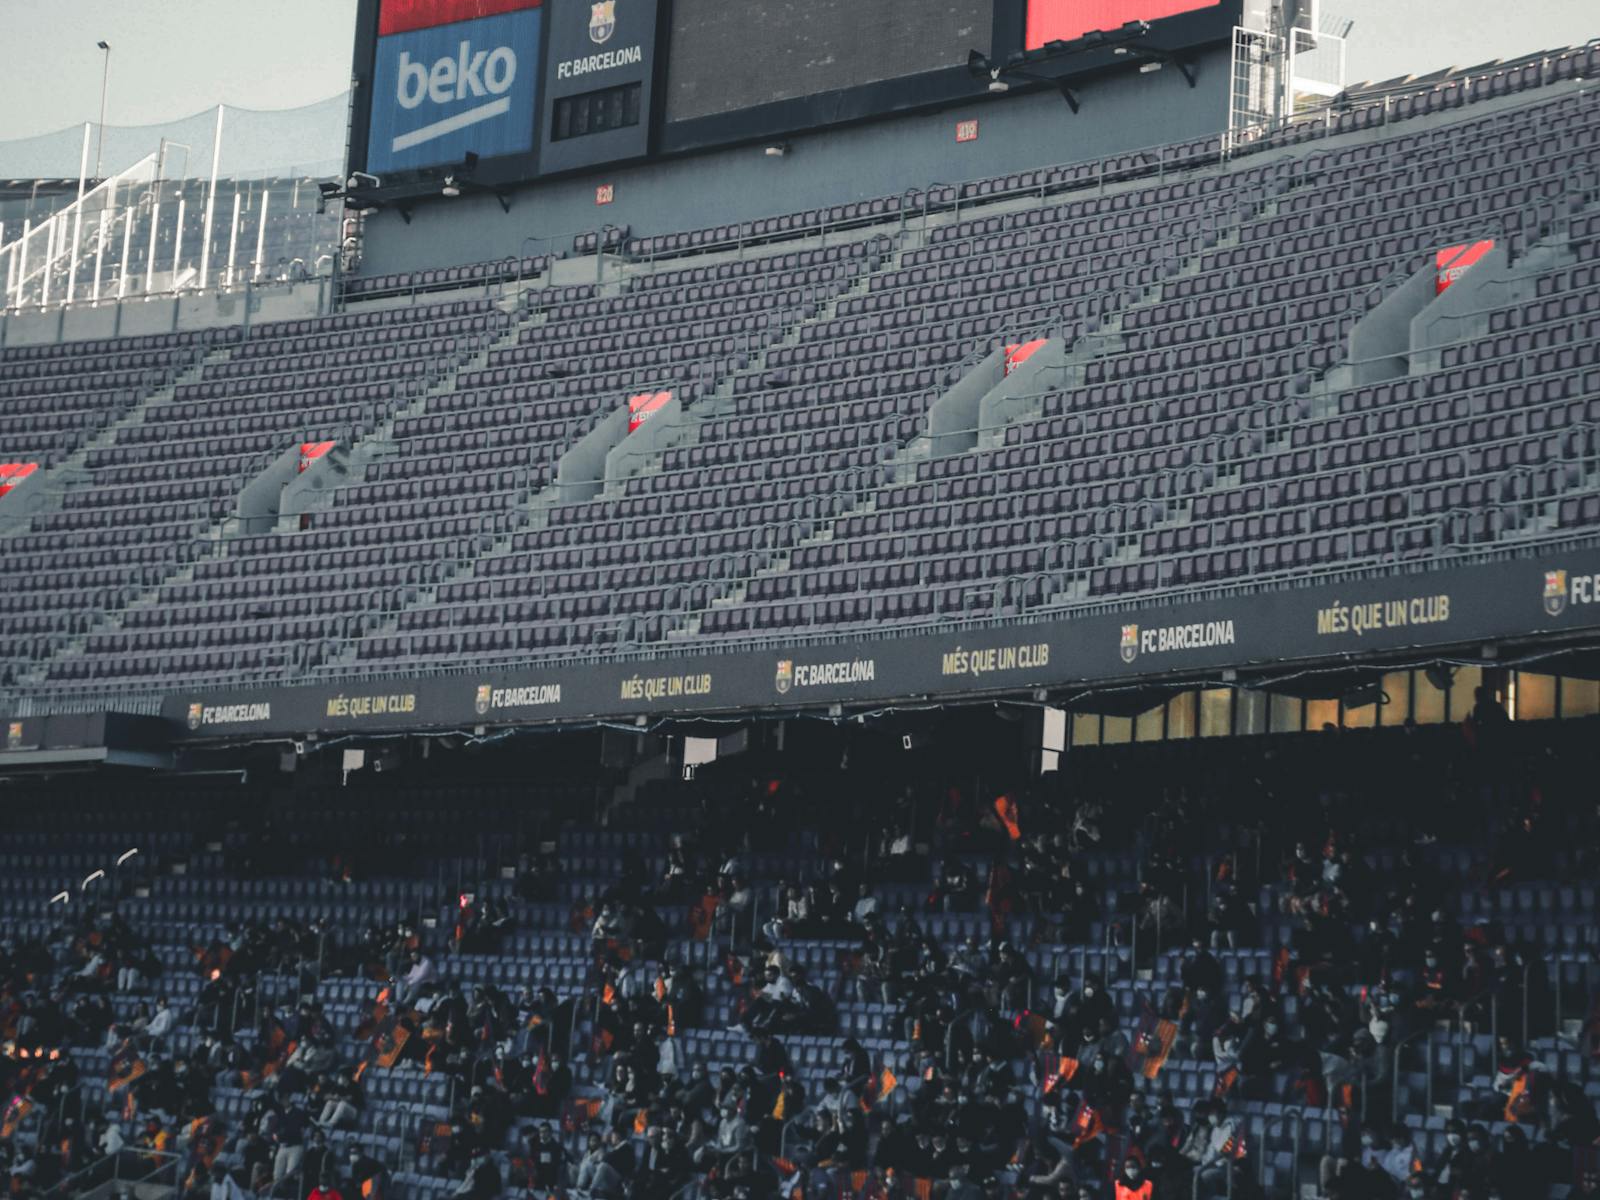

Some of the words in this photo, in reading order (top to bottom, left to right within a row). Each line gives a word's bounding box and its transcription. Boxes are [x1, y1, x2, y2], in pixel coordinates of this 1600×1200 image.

[397, 40, 517, 110] beko
[558, 61, 572, 80] FC
[573, 45, 642, 76] BARCELONA
[1571, 576, 1592, 605] FC
[1317, 600, 1348, 635] MÉS
[1351, 604, 1381, 636] QUE
[1385, 601, 1408, 627] UN
[1410, 595, 1449, 623] CLUB
[1141, 629, 1156, 654] FC
[1158, 620, 1234, 650] BARCELONA
[794, 665, 809, 686] FC
[810, 659, 874, 684] BARCELONA
[942, 646, 968, 675] MÉS
[971, 648, 996, 677] QUE
[997, 646, 1015, 670] UN
[1017, 643, 1049, 667] CLUB
[491, 689, 505, 708] FC
[505, 684, 561, 705] BARCELONA
[621, 674, 644, 699] MÉS
[645, 676, 668, 701] QUE
[668, 675, 683, 695] UN
[684, 673, 711, 694] CLUB
[202, 707, 215, 724] FC
[215, 702, 271, 723] BARCELONA
[327, 694, 348, 716] MÉS
[350, 696, 371, 718] QUE
[372, 695, 387, 714] UN
[388, 694, 416, 712] CLUB
